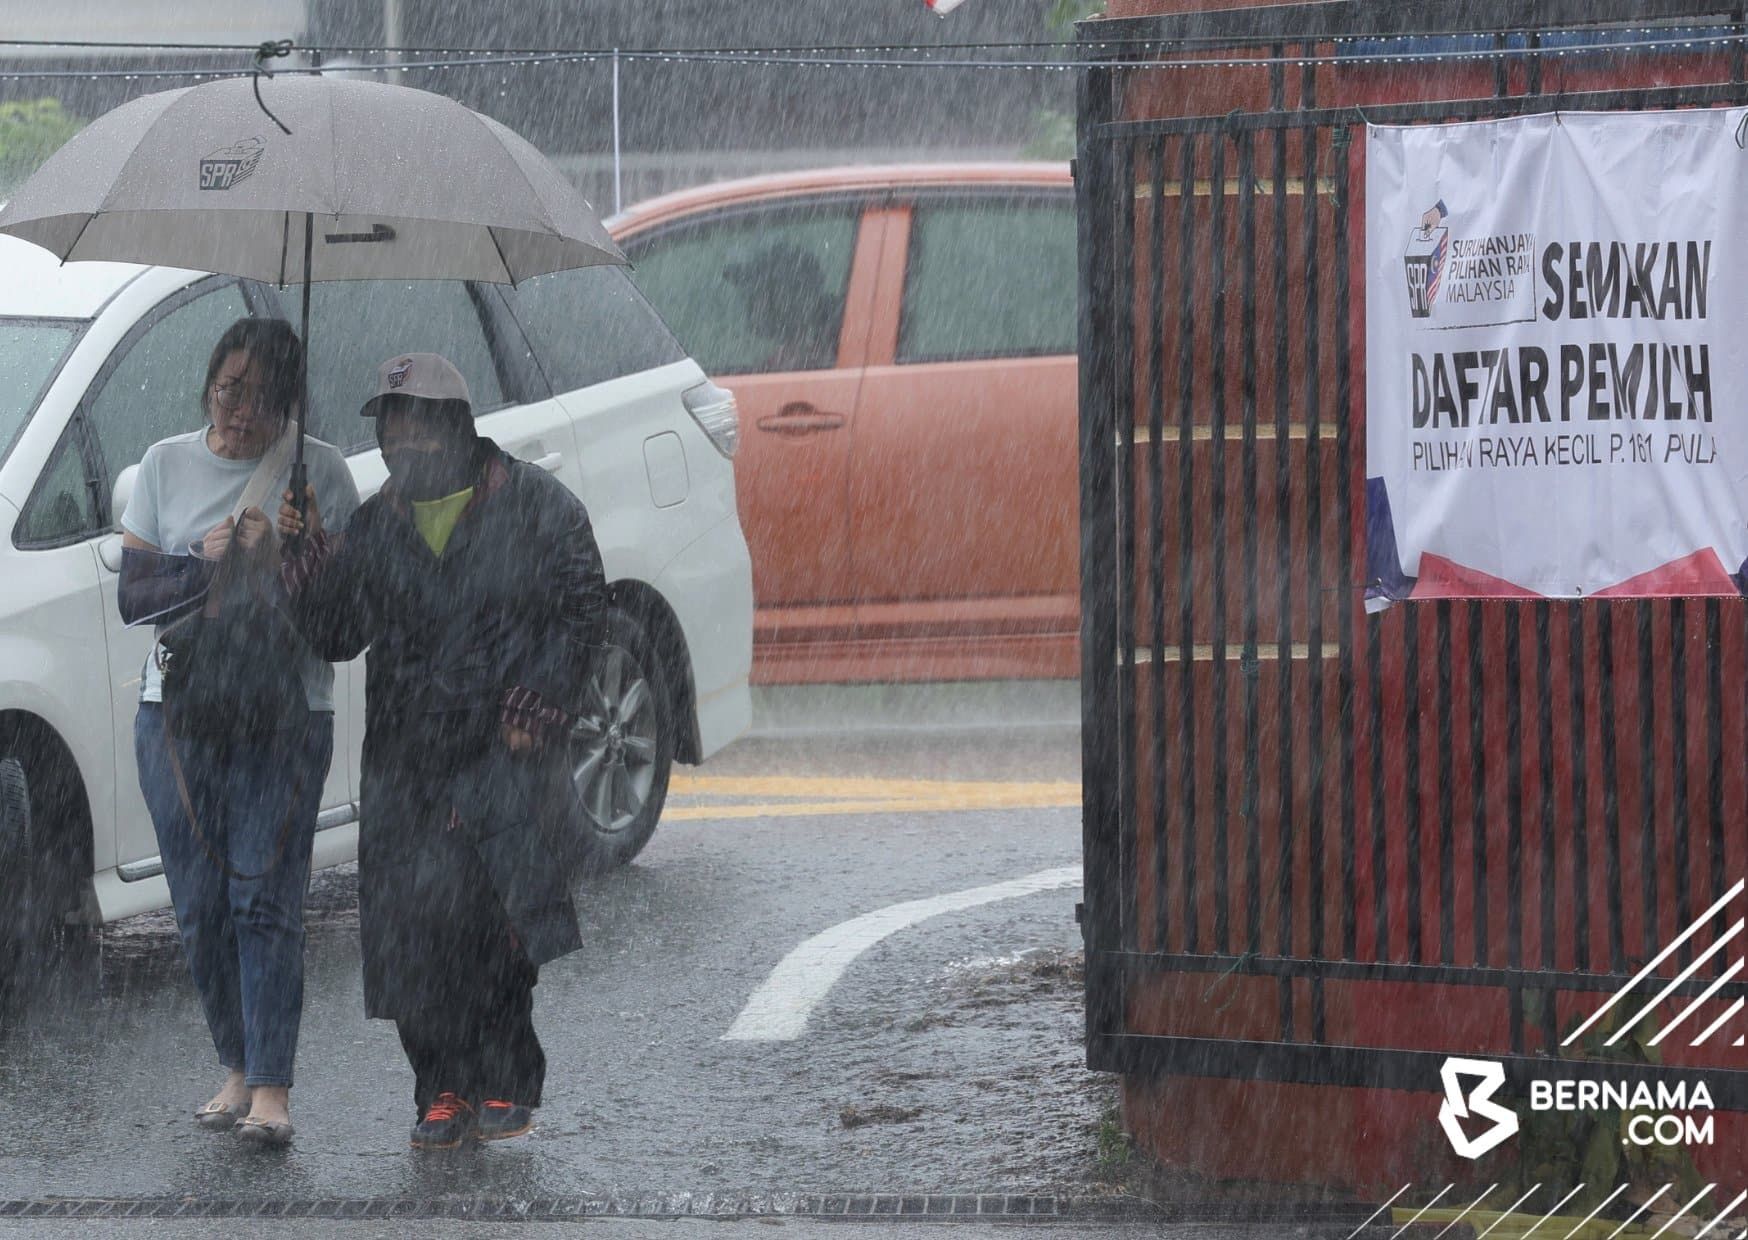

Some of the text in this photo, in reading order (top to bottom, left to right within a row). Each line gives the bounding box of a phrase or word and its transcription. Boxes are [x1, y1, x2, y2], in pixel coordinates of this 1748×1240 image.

[201, 163, 237, 187] SPR
[1449, 258, 1502, 280] PILIHAN
[1542, 240, 1711, 321] SEMAKAN
[1406, 263, 1429, 311] SPR
[1446, 279, 1515, 304] MALAYSIA
[1411, 346, 1552, 429] DAFTAR
[1480, 437, 1539, 467] RAYA
[1545, 435, 1602, 465] KECIL
[1610, 434, 1625, 464] P.
